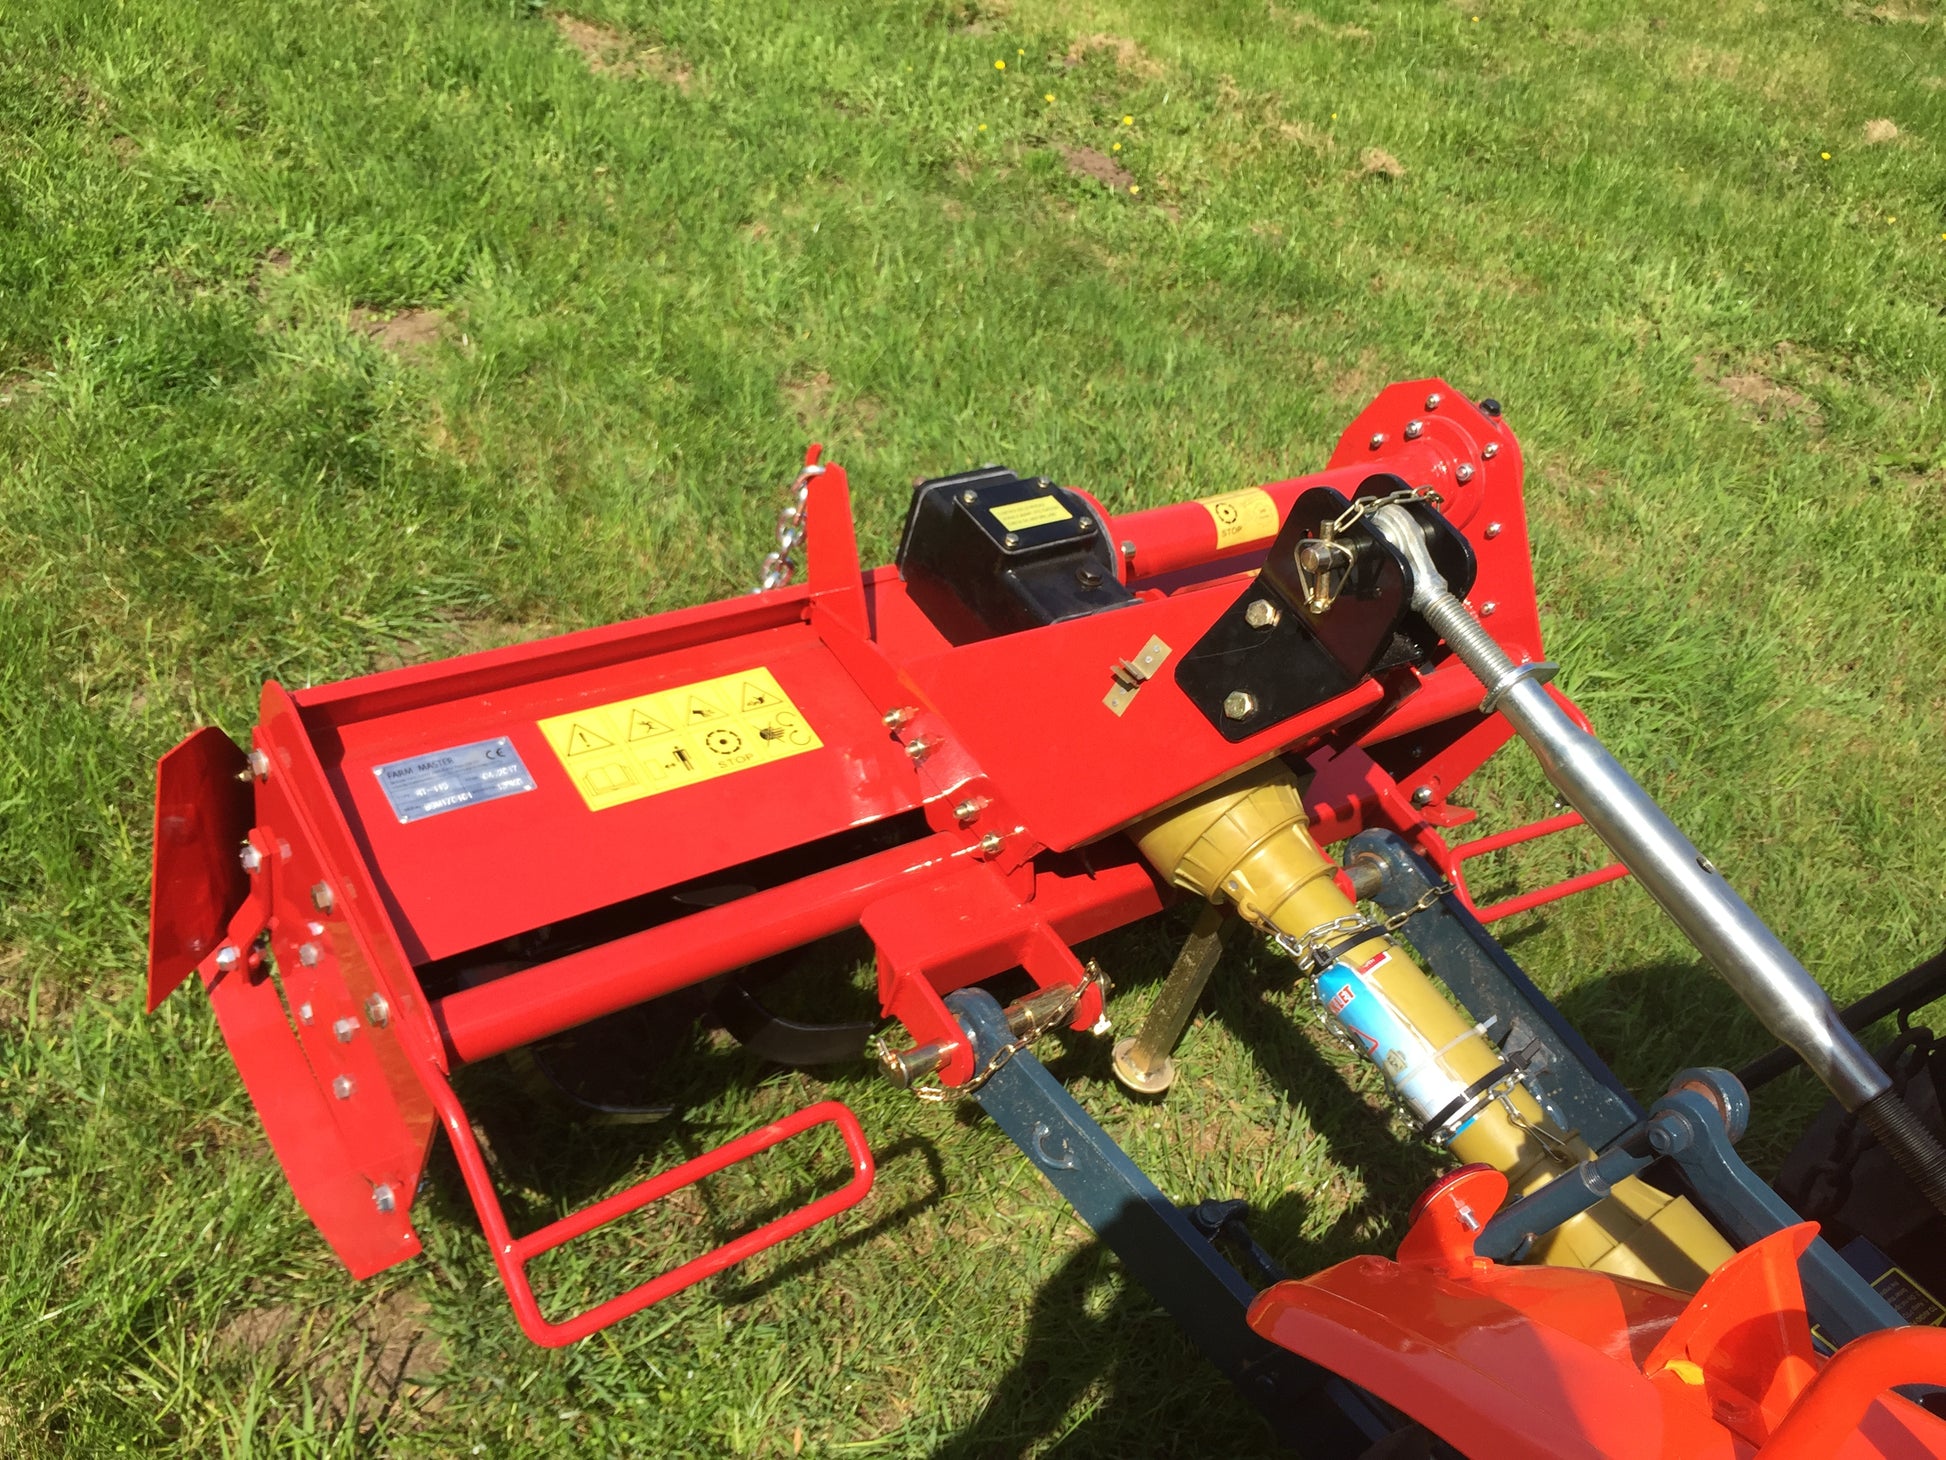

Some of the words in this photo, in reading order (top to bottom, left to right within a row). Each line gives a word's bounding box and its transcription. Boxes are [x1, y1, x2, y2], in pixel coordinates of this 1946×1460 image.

[1222, 526, 1242, 538] STOP
[485, 748, 506, 760] CE
[718, 753, 754, 769] STOP
[386, 768, 413, 779] FARM
[418, 757, 454, 771] MASTER
